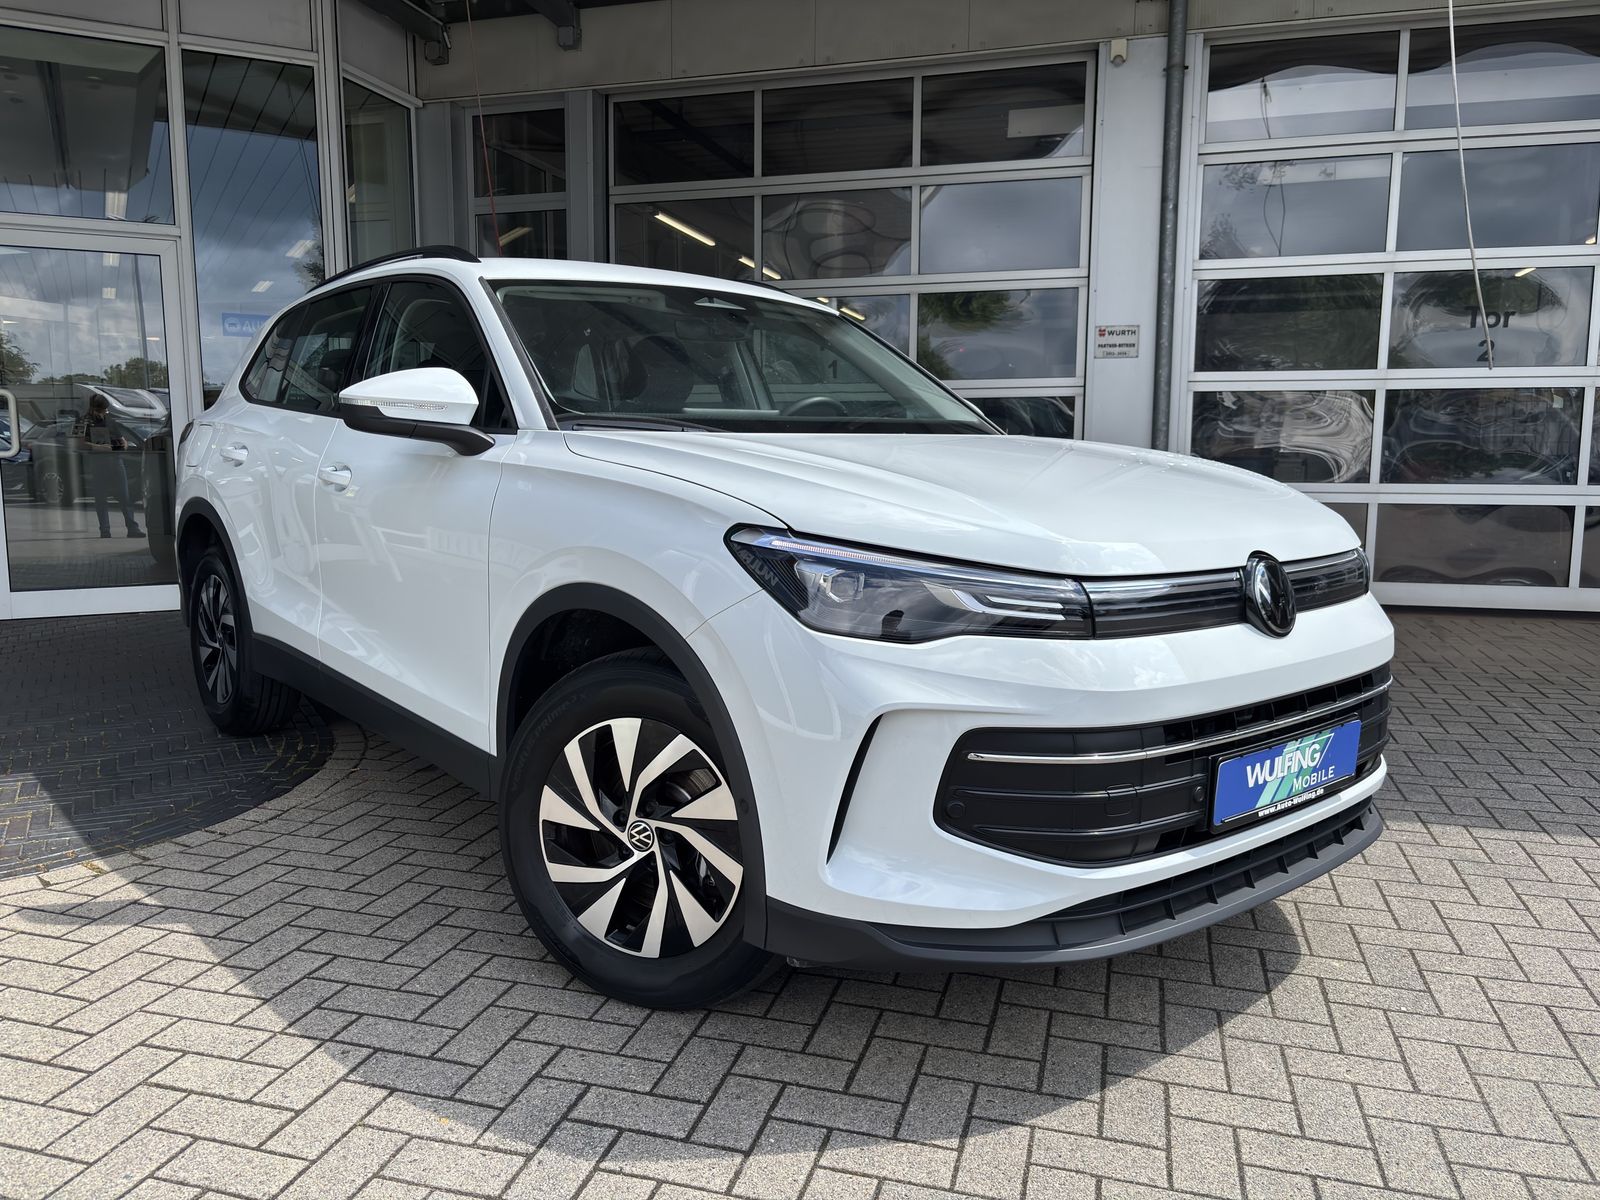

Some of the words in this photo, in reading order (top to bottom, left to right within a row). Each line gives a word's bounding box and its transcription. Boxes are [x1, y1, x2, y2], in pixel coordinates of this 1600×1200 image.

[1464, 306, 1516, 328] Tor
[1476, 339, 1495, 362] 2
[1246, 743, 1321, 788] WULFING
[1292, 766, 1336, 793] MOBILE
